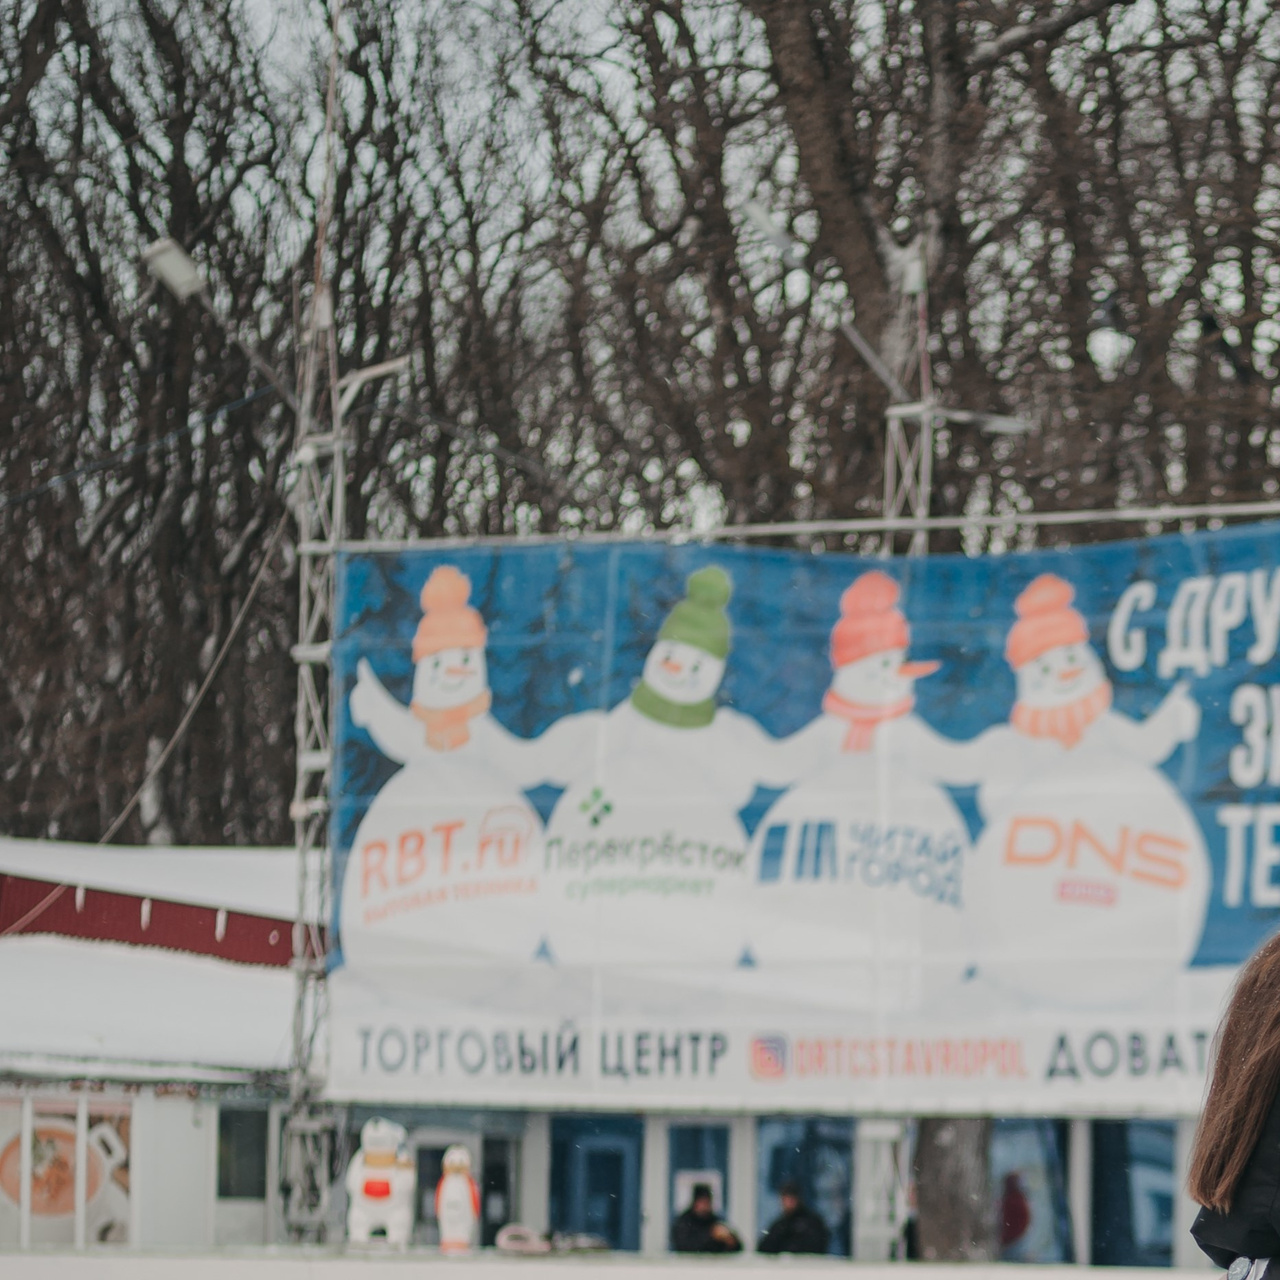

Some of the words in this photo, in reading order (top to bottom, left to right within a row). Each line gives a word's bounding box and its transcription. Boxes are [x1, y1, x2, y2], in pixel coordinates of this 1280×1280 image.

[1108, 581, 1157, 671] С
[360, 819, 522, 899] RBT.ru
[1003, 817, 1189, 890] DNS
[357, 1018, 581, 1077] ТОРГОВЫЙ
[600, 1029, 730, 1081] ЦЕНТР
